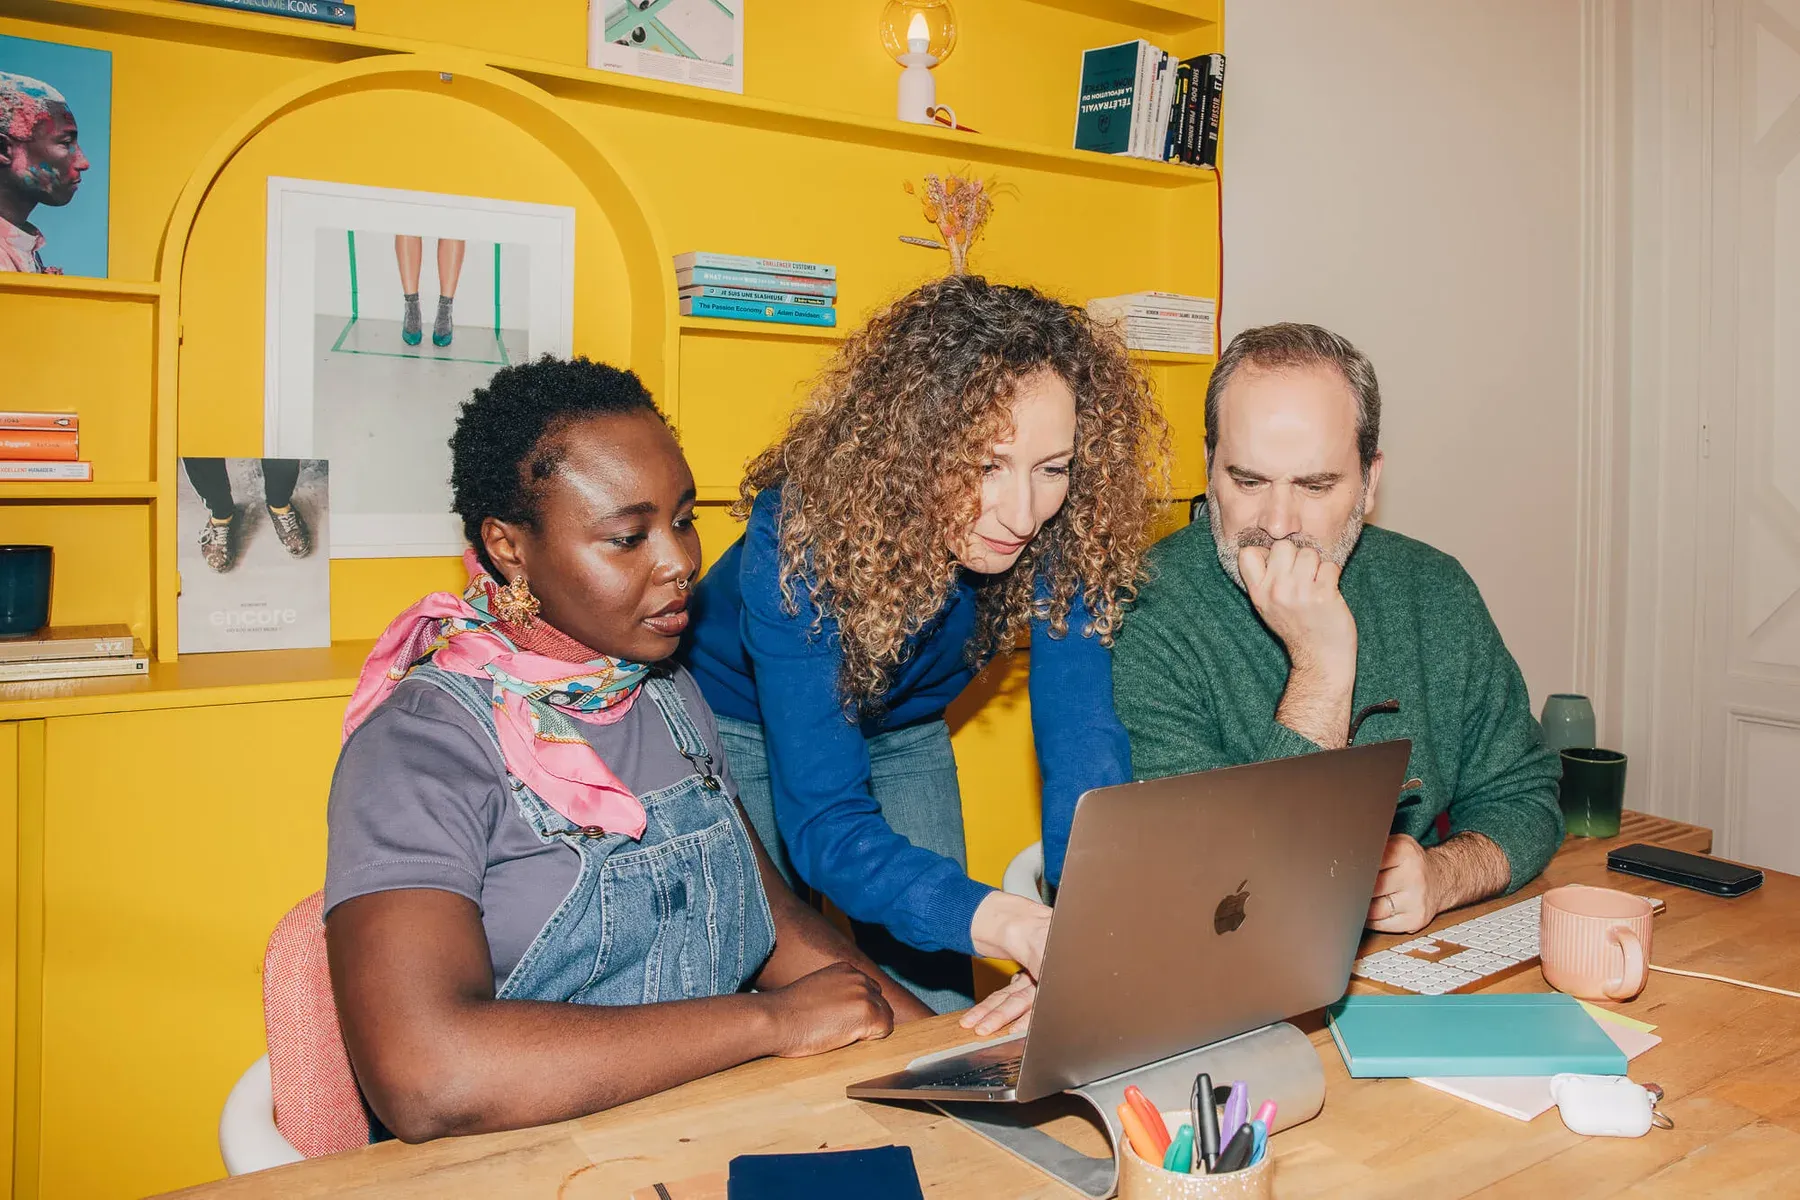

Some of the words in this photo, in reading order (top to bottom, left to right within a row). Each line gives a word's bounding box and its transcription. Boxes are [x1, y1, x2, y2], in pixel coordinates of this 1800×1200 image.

[287, 0, 318, 15] ICONS
[1192, 68, 1200, 87] SHOE
[1214, 81, 1222, 91] ET
[1091, 89, 1125, 100] RÉVOLUTION
[1190, 87, 1198, 102] DOG
[1081, 97, 1131, 113] TÉLÉTRAVAIL
[1187, 125, 1195, 149] KNIGHT
[762, 260, 792, 269] CHALLENGER
[792, 263, 817, 271] CUSTOMER
[703, 272, 722, 281] WHAT
[754, 293, 784, 301] SLASHEUSE
[699, 302, 711, 310] The
[712, 303, 735, 312] Passion
[736, 306, 762, 315] Economy
[777, 309, 794, 317] Adam
[795, 311, 821, 319] Davidson
[209, 607, 297, 626] encore
